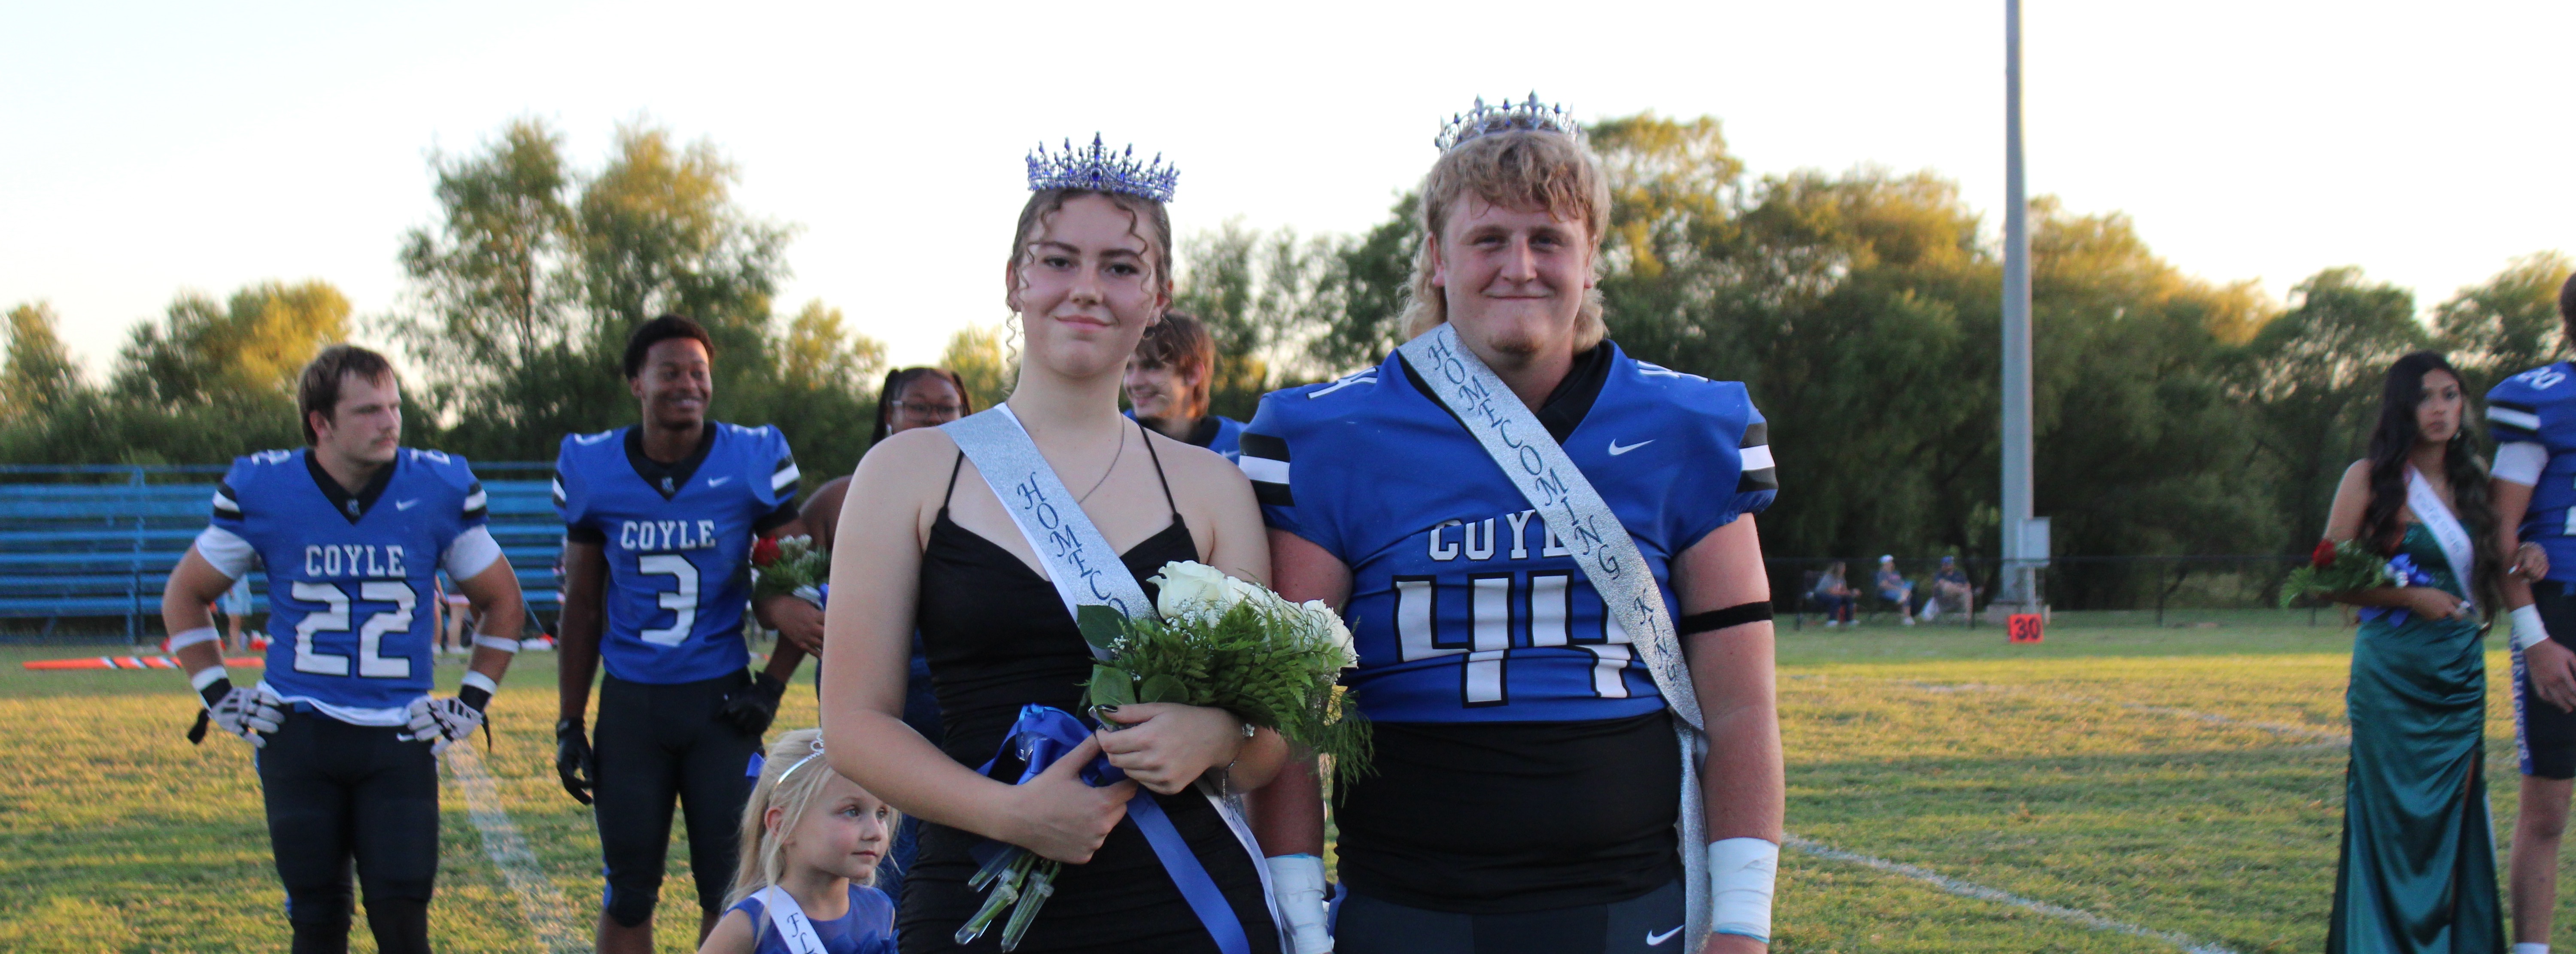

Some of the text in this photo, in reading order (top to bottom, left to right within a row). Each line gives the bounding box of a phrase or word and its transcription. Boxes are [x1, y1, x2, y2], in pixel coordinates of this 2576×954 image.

[620, 519, 716, 551] COYLE
[1428, 331, 1677, 687] HOMECOMING KING
[1428, 508, 1572, 562] COYL
[305, 544, 407, 578] COYLE
[638, 553, 700, 647] 3
[291, 580, 417, 679] 22
[1392, 569, 1633, 708] 44
[2014, 616, 2042, 641] 30
[787, 912, 816, 954] FL
